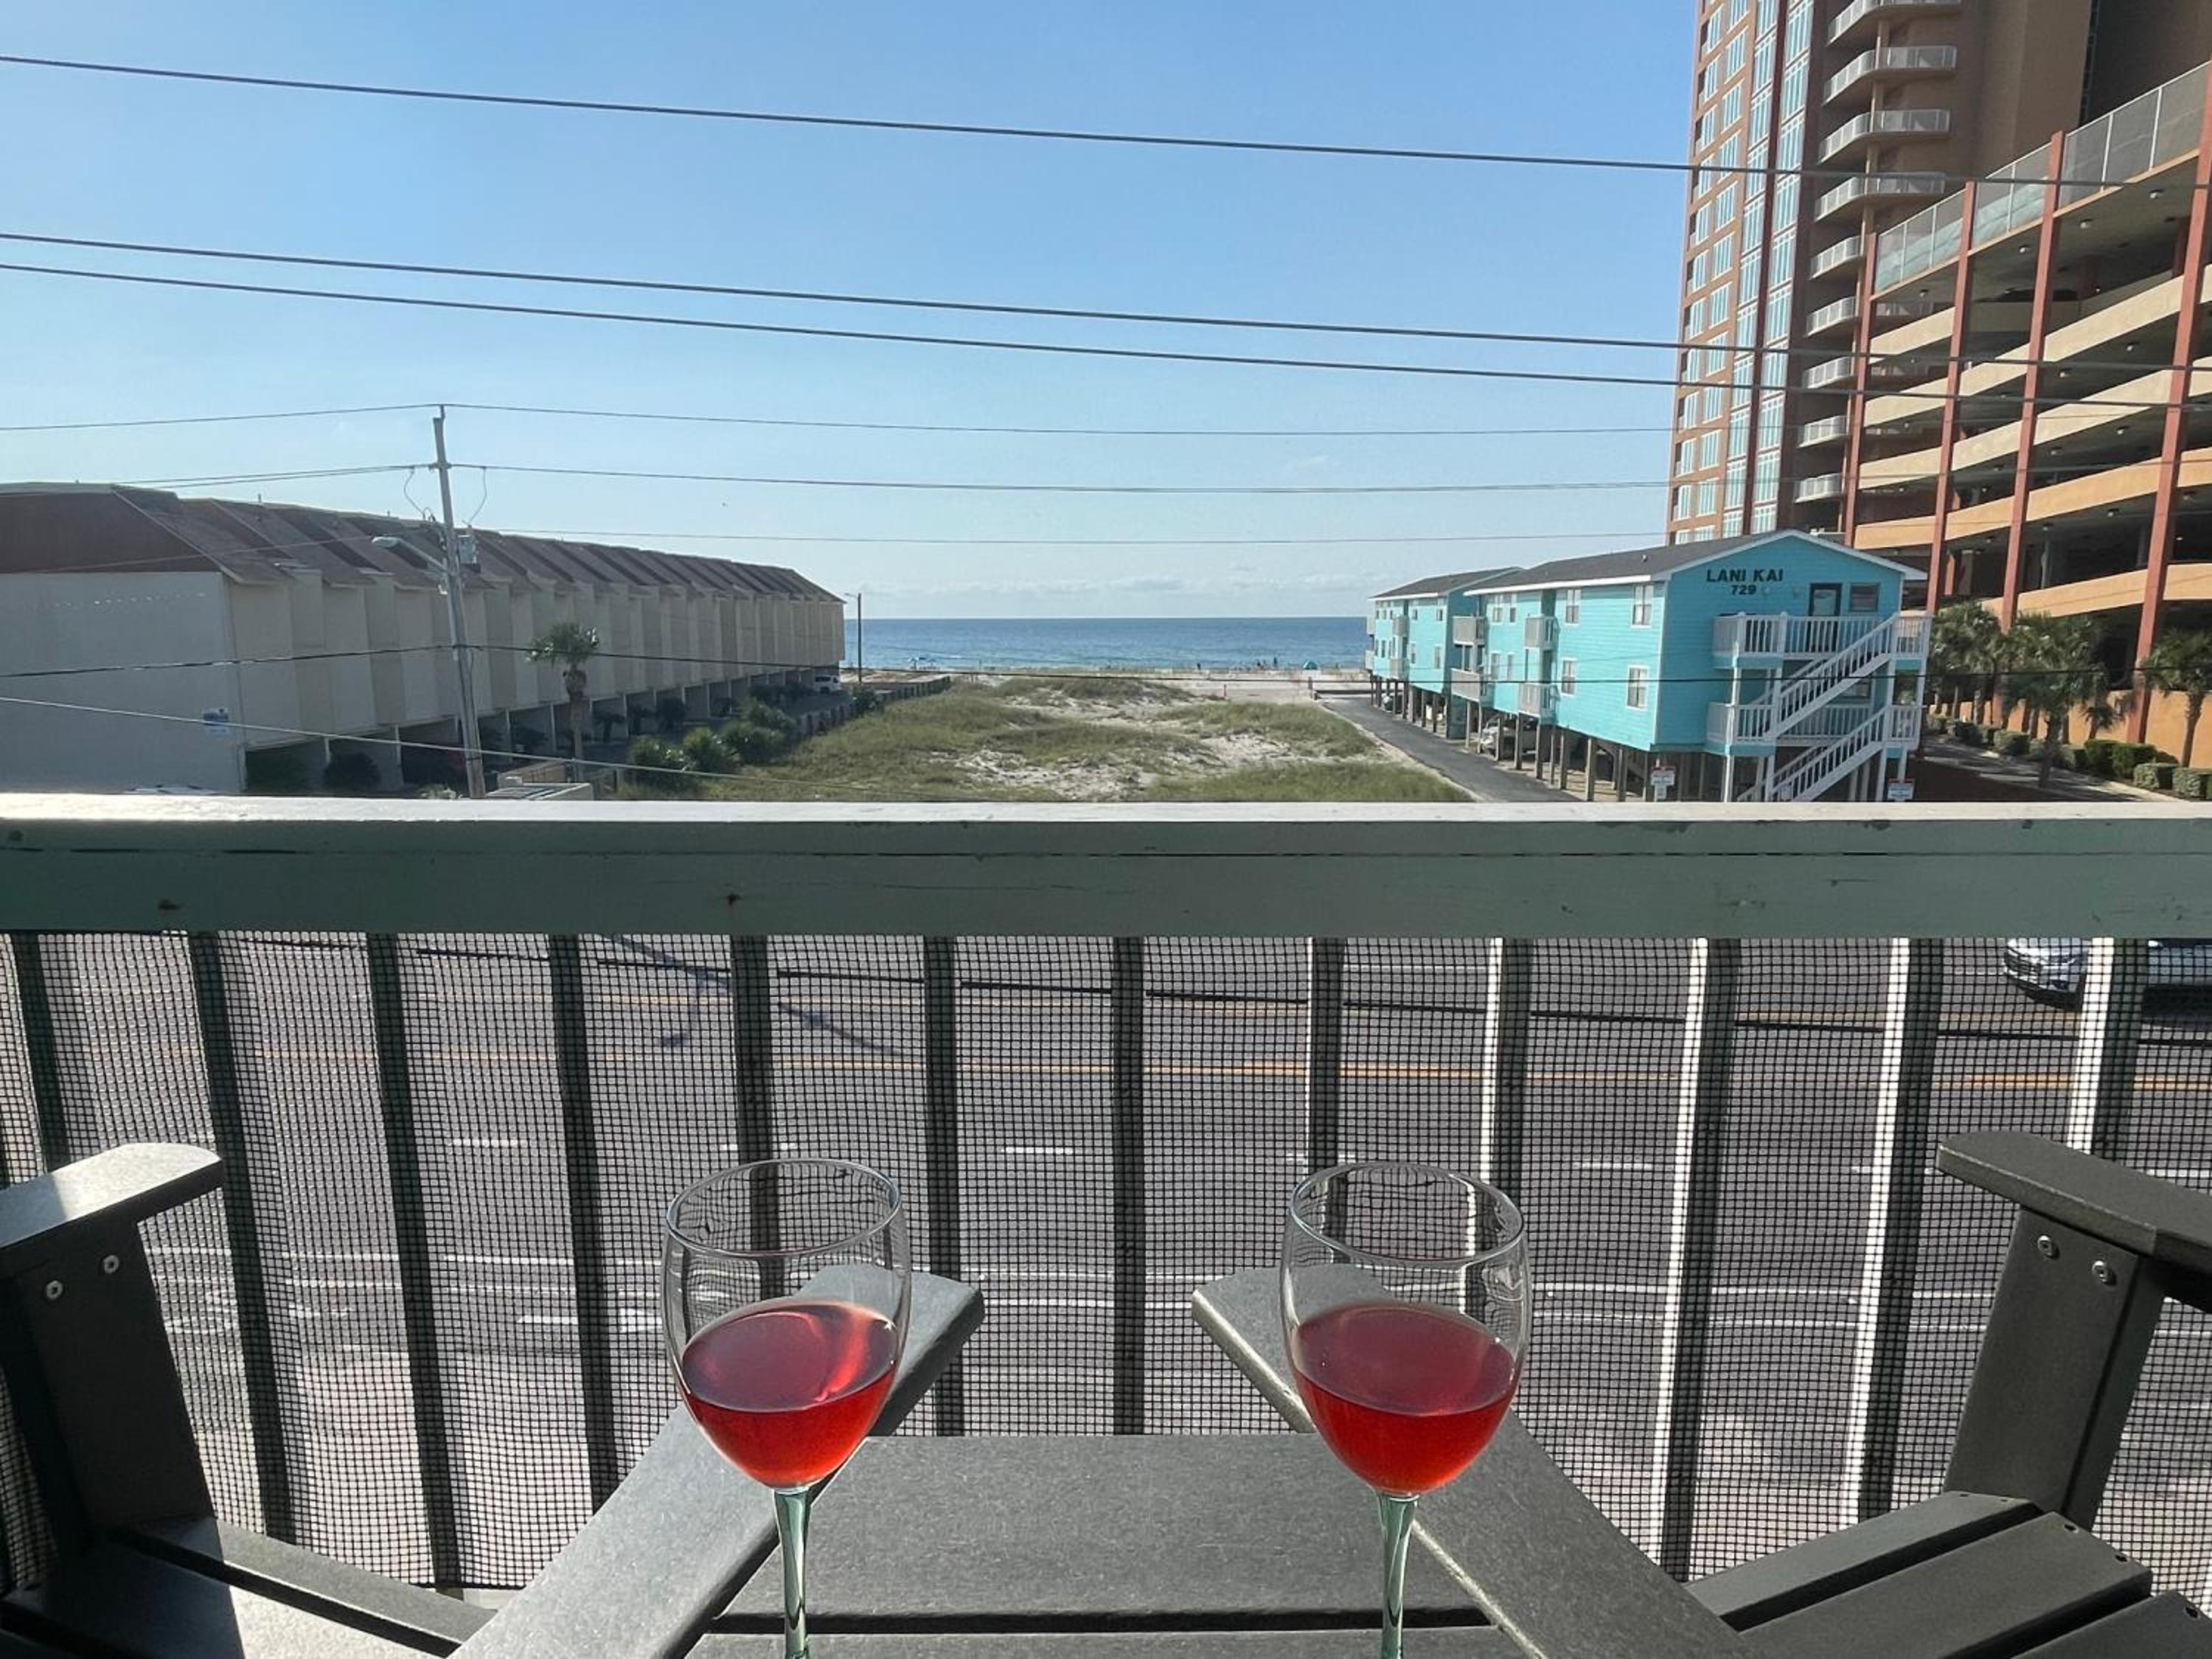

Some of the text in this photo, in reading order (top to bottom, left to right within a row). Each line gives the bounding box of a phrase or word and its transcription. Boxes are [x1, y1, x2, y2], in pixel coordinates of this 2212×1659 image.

[1706, 568, 1784, 582] LANI KAI
[1730, 585, 1757, 596] 729
